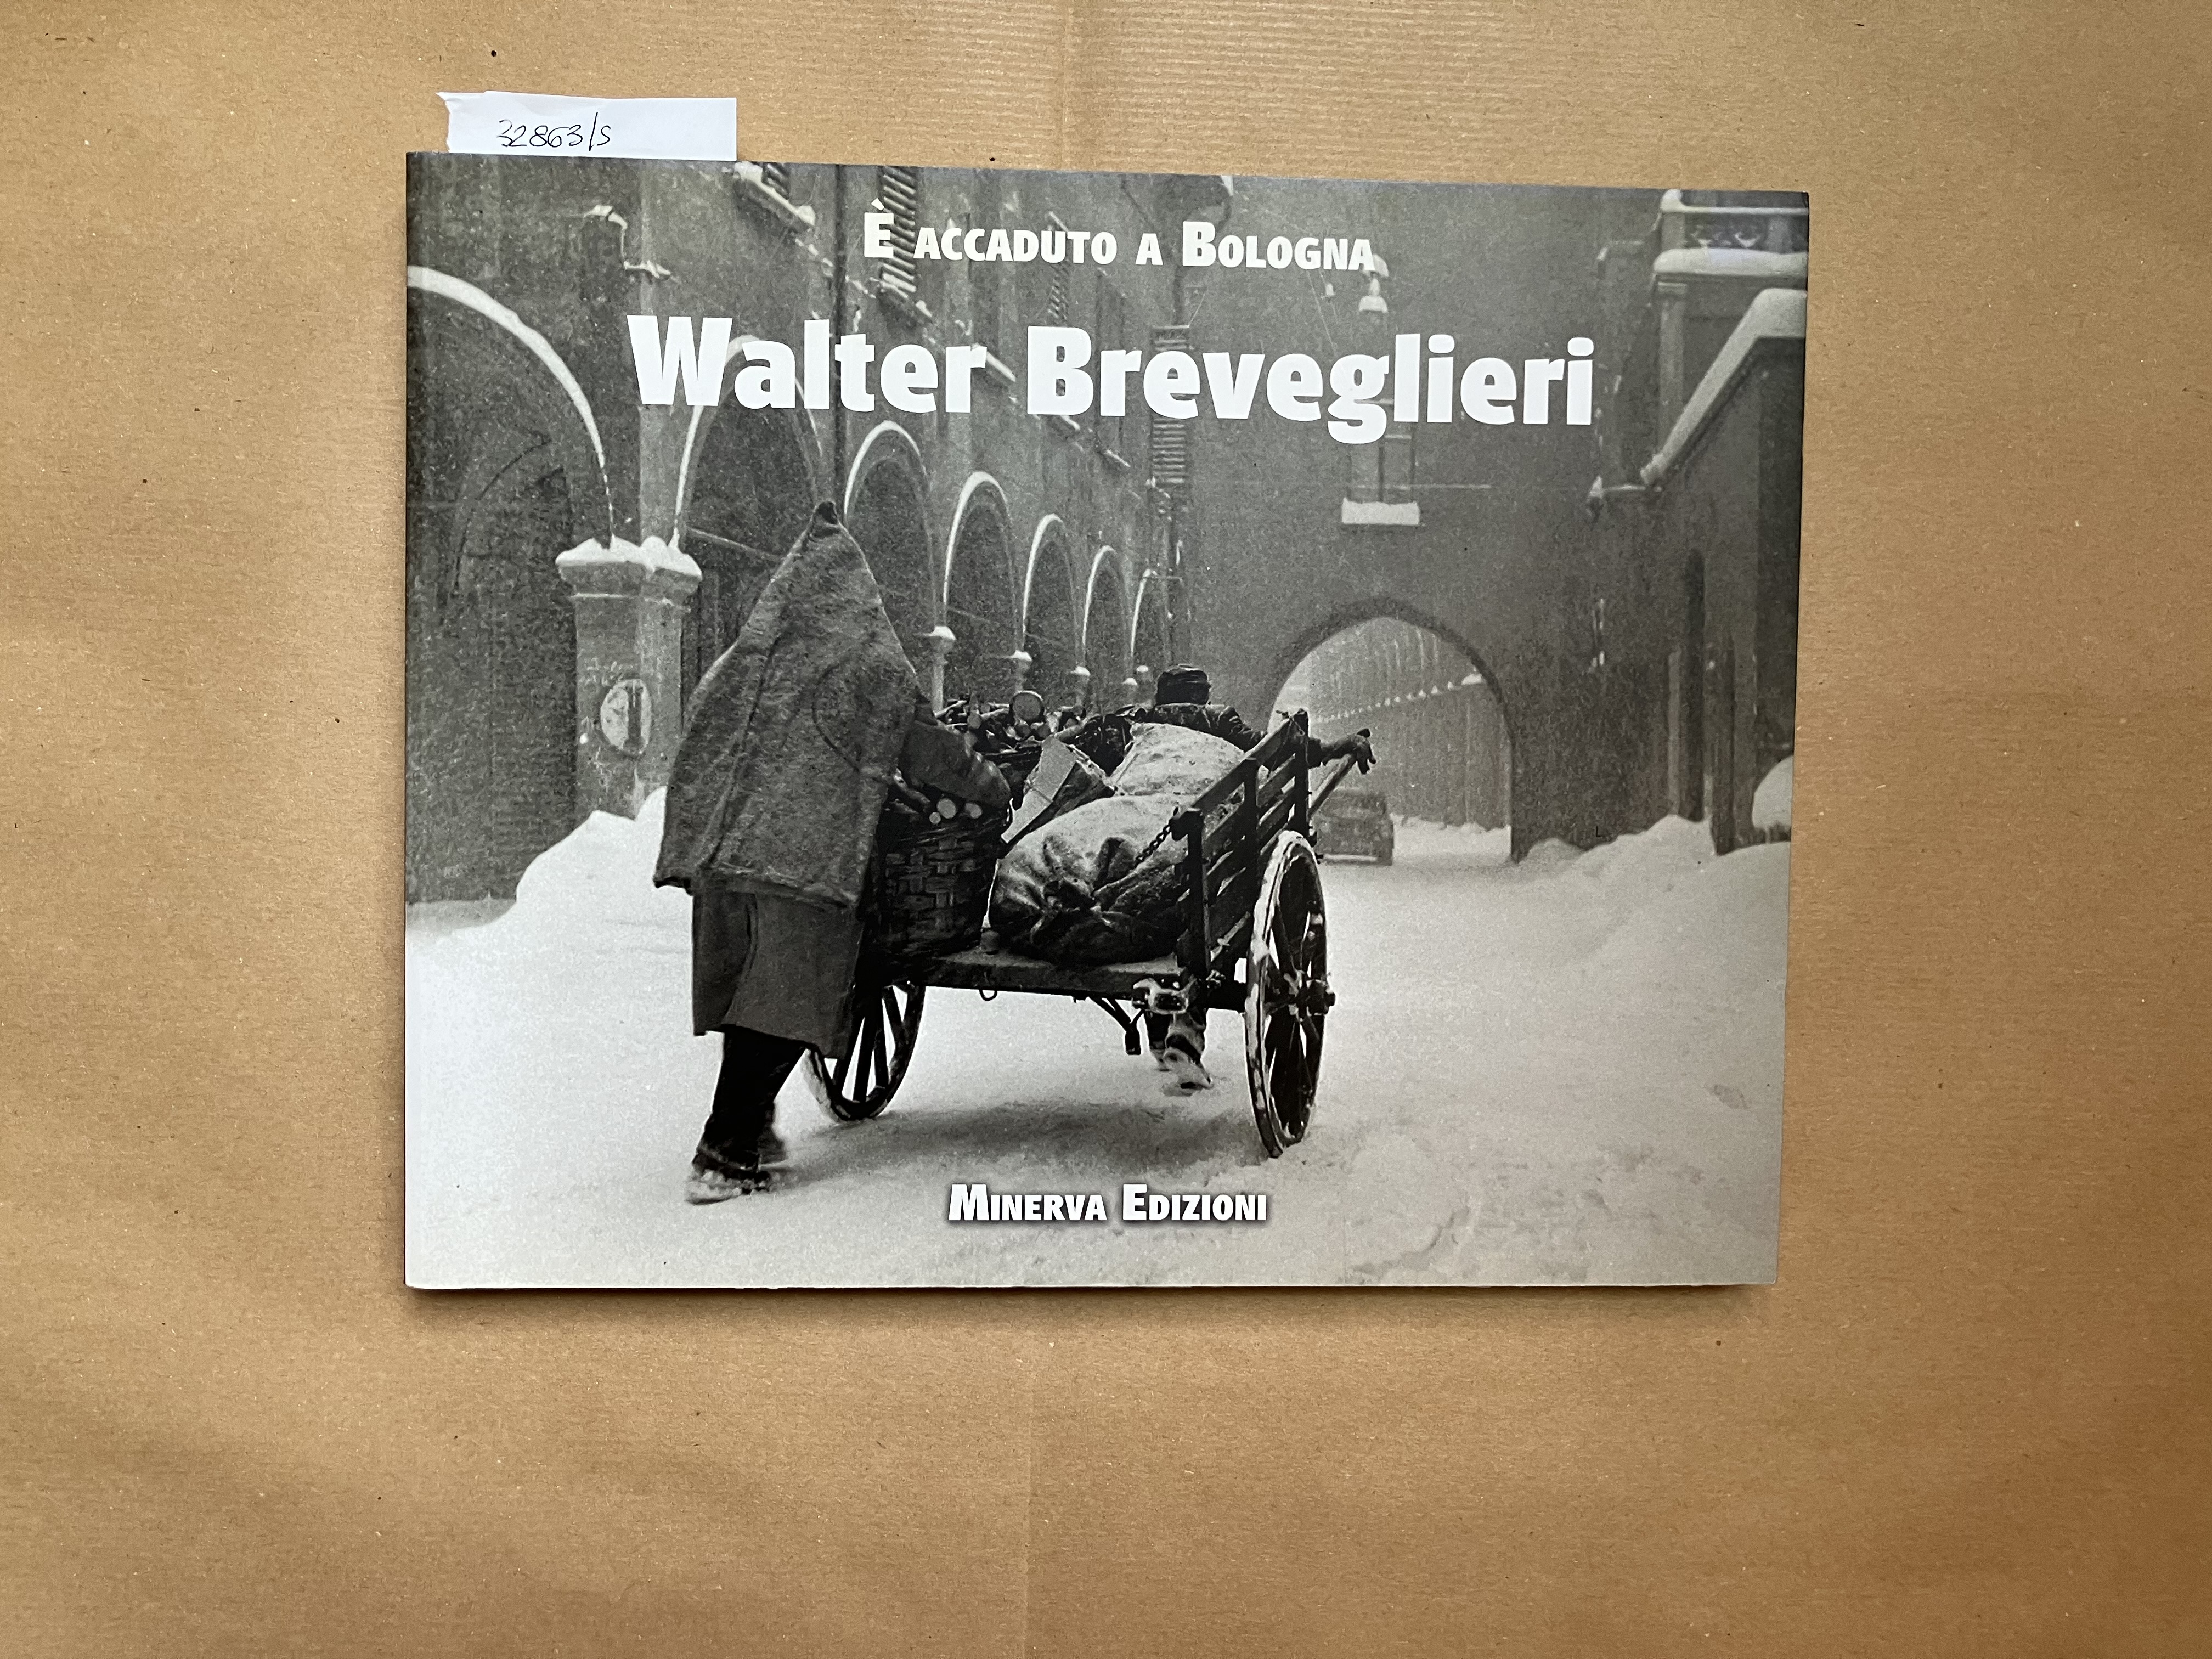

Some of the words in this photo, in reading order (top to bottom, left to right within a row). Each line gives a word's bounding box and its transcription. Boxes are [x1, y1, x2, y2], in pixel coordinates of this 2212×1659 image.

[863, 198, 894, 258] È
[913, 227, 1118, 264] ACCADUTO
[1135, 233, 1164, 266] A
[1182, 221, 1376, 271] BOLOGNA
[627, 314, 988, 414] Walter
[1026, 325, 1594, 444] Breveglieri
[948, 1184, 1107, 1221] MINERVA
[1122, 1184, 1267, 1221] EDIZIONI
